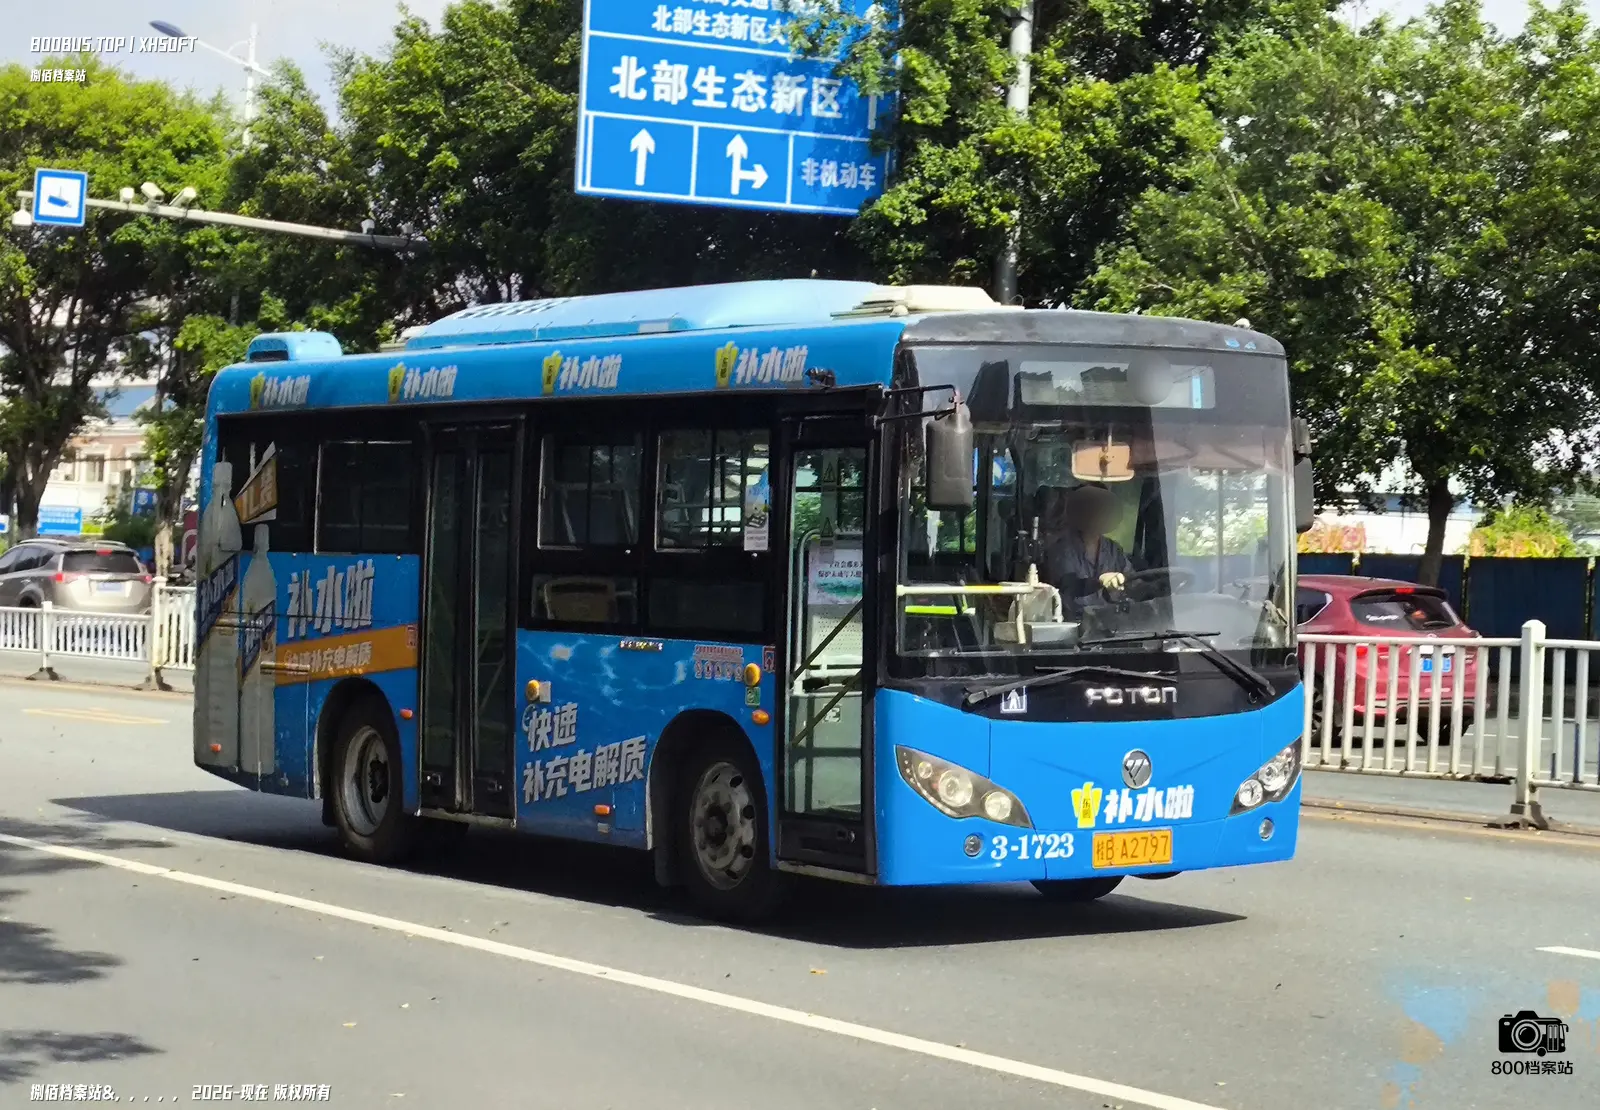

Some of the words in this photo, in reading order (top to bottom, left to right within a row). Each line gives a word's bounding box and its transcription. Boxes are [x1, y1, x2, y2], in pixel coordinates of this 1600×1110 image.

[609, 55, 843, 118] 北部生态新区
[801, 157, 876, 190] 非机动车
[404, 365, 458, 399] 补水啦
[558, 353, 622, 390] 补水啦
[736, 345, 808, 384] 补水啦
[263, 374, 311, 406] 补水啦
[287, 559, 375, 638] 补水啦
[1084, 686, 1178, 706] FOTON
[526, 702, 578, 752] 快速
[523, 735, 646, 804] 补充电解质
[1103, 784, 1194, 824] 补水啦
[990, 832, 1074, 860] 3-1723
